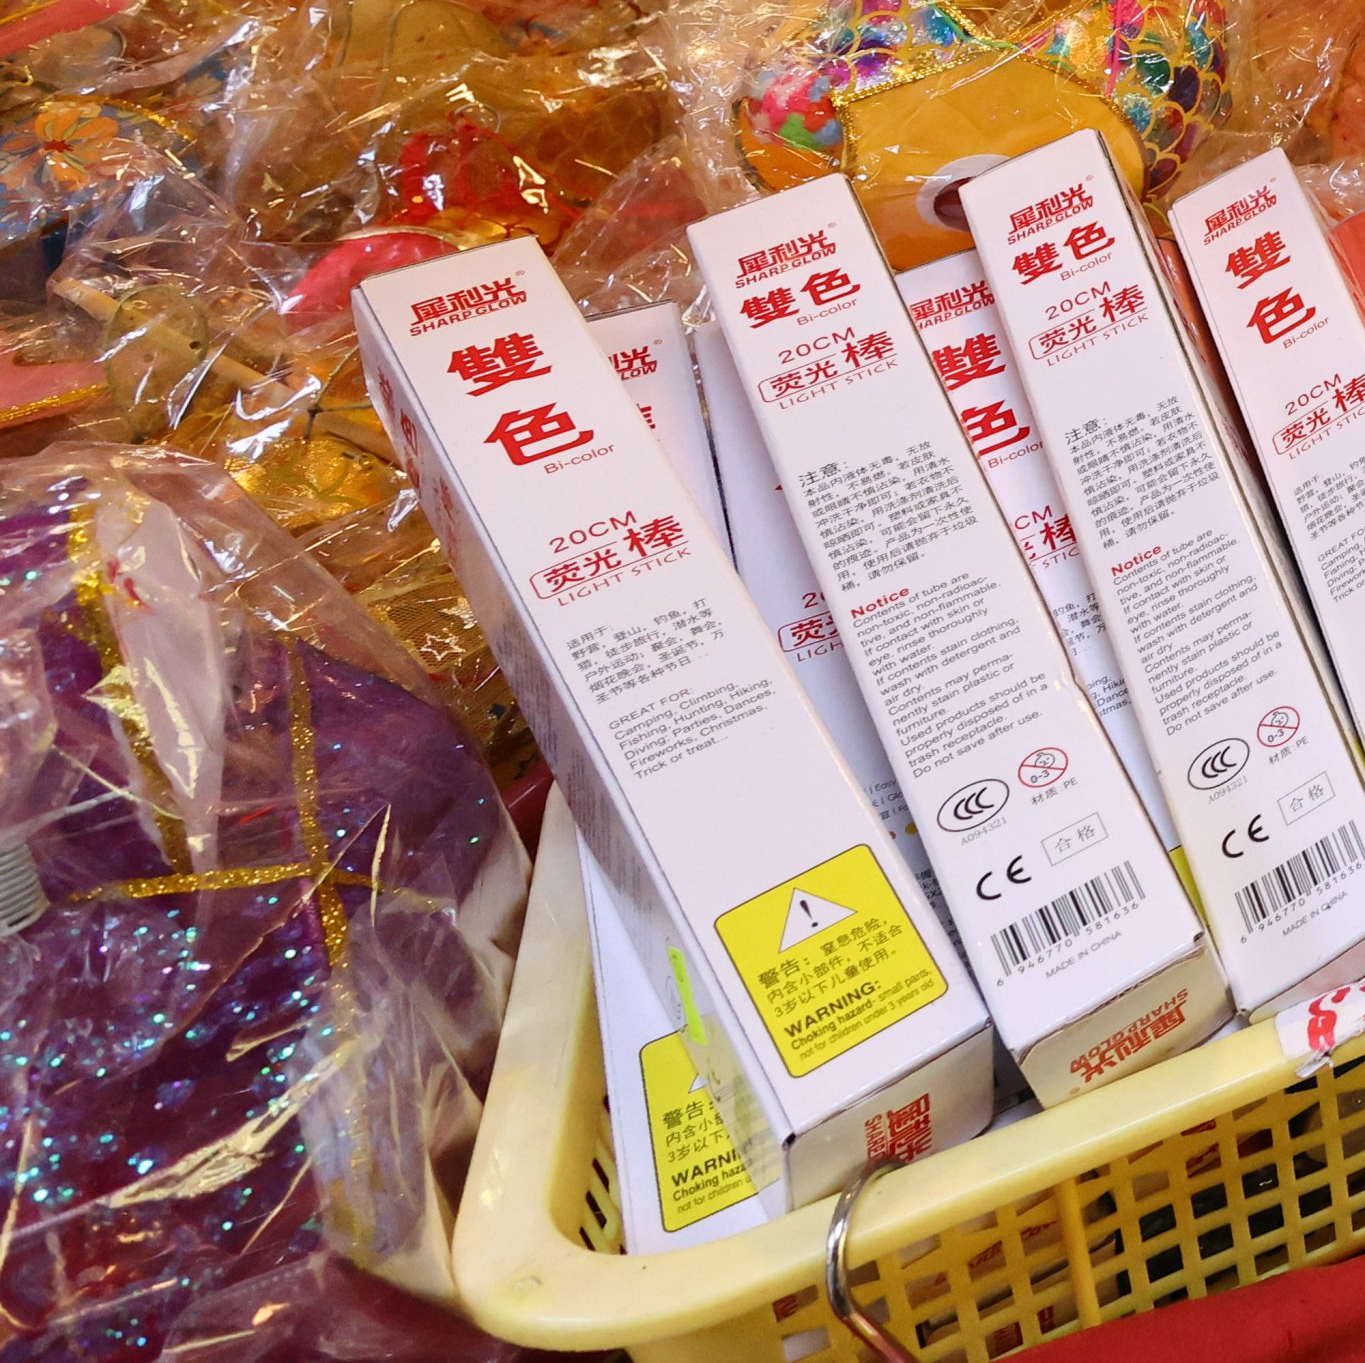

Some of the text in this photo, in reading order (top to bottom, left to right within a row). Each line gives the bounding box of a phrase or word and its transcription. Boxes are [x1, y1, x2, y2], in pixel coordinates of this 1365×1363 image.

[1006, 197, 1094, 246] SHARP GLOW
[1202, 195, 1277, 246] SHARP GLOW
[734, 243, 837, 289] SHARP GLOW
[1059, 251, 1112, 281] Bi-color
[1223, 229, 1292, 290] 雙
[408, 291, 528, 337] SHARP GLOW
[795, 297, 857, 326] Bi-color
[1044, 279, 1111, 321] 20CM
[1245, 285, 1317, 345] 色
[777, 325, 856, 365] 20CM
[1046, 312, 1149, 367] LIGHT STICK
[1282, 316, 1329, 349] Bi-color
[445, 331, 553, 398] 雙
[778, 358, 898, 410] LIGHT STICK
[1283, 372, 1342, 416] 20CM
[481, 401, 595, 467] 色
[1288, 426, 1332, 460] LIGHT
[542, 443, 615, 474] Bi-color
[548, 509, 637, 554] 20CM
[556, 546, 692, 607] LIGHT STICK
[1110, 545, 1162, 577] Notice
[849, 587, 910, 620] Notice
[852, 572, 969, 628] Contents of tube are
[915, 576, 988, 610] non-radioac-
[863, 597, 984, 657] If contact with skin or
[888, 618, 911, 635] and
[896, 635, 926, 653] rinse
[927, 607, 988, 638] thoroughly
[608, 701, 655, 730] GREAT
[633, 760, 668, 779] Trick
[669, 751, 683, 763] or
[1281, 914, 1308, 937] MADE
[1045, 930, 1121, 978] MADE IN CHINA
[783, 979, 881, 1037] WARNING:
[1070, 989, 1189, 1072] SHARP GLOW
[790, 1020, 837, 1050] Choking
